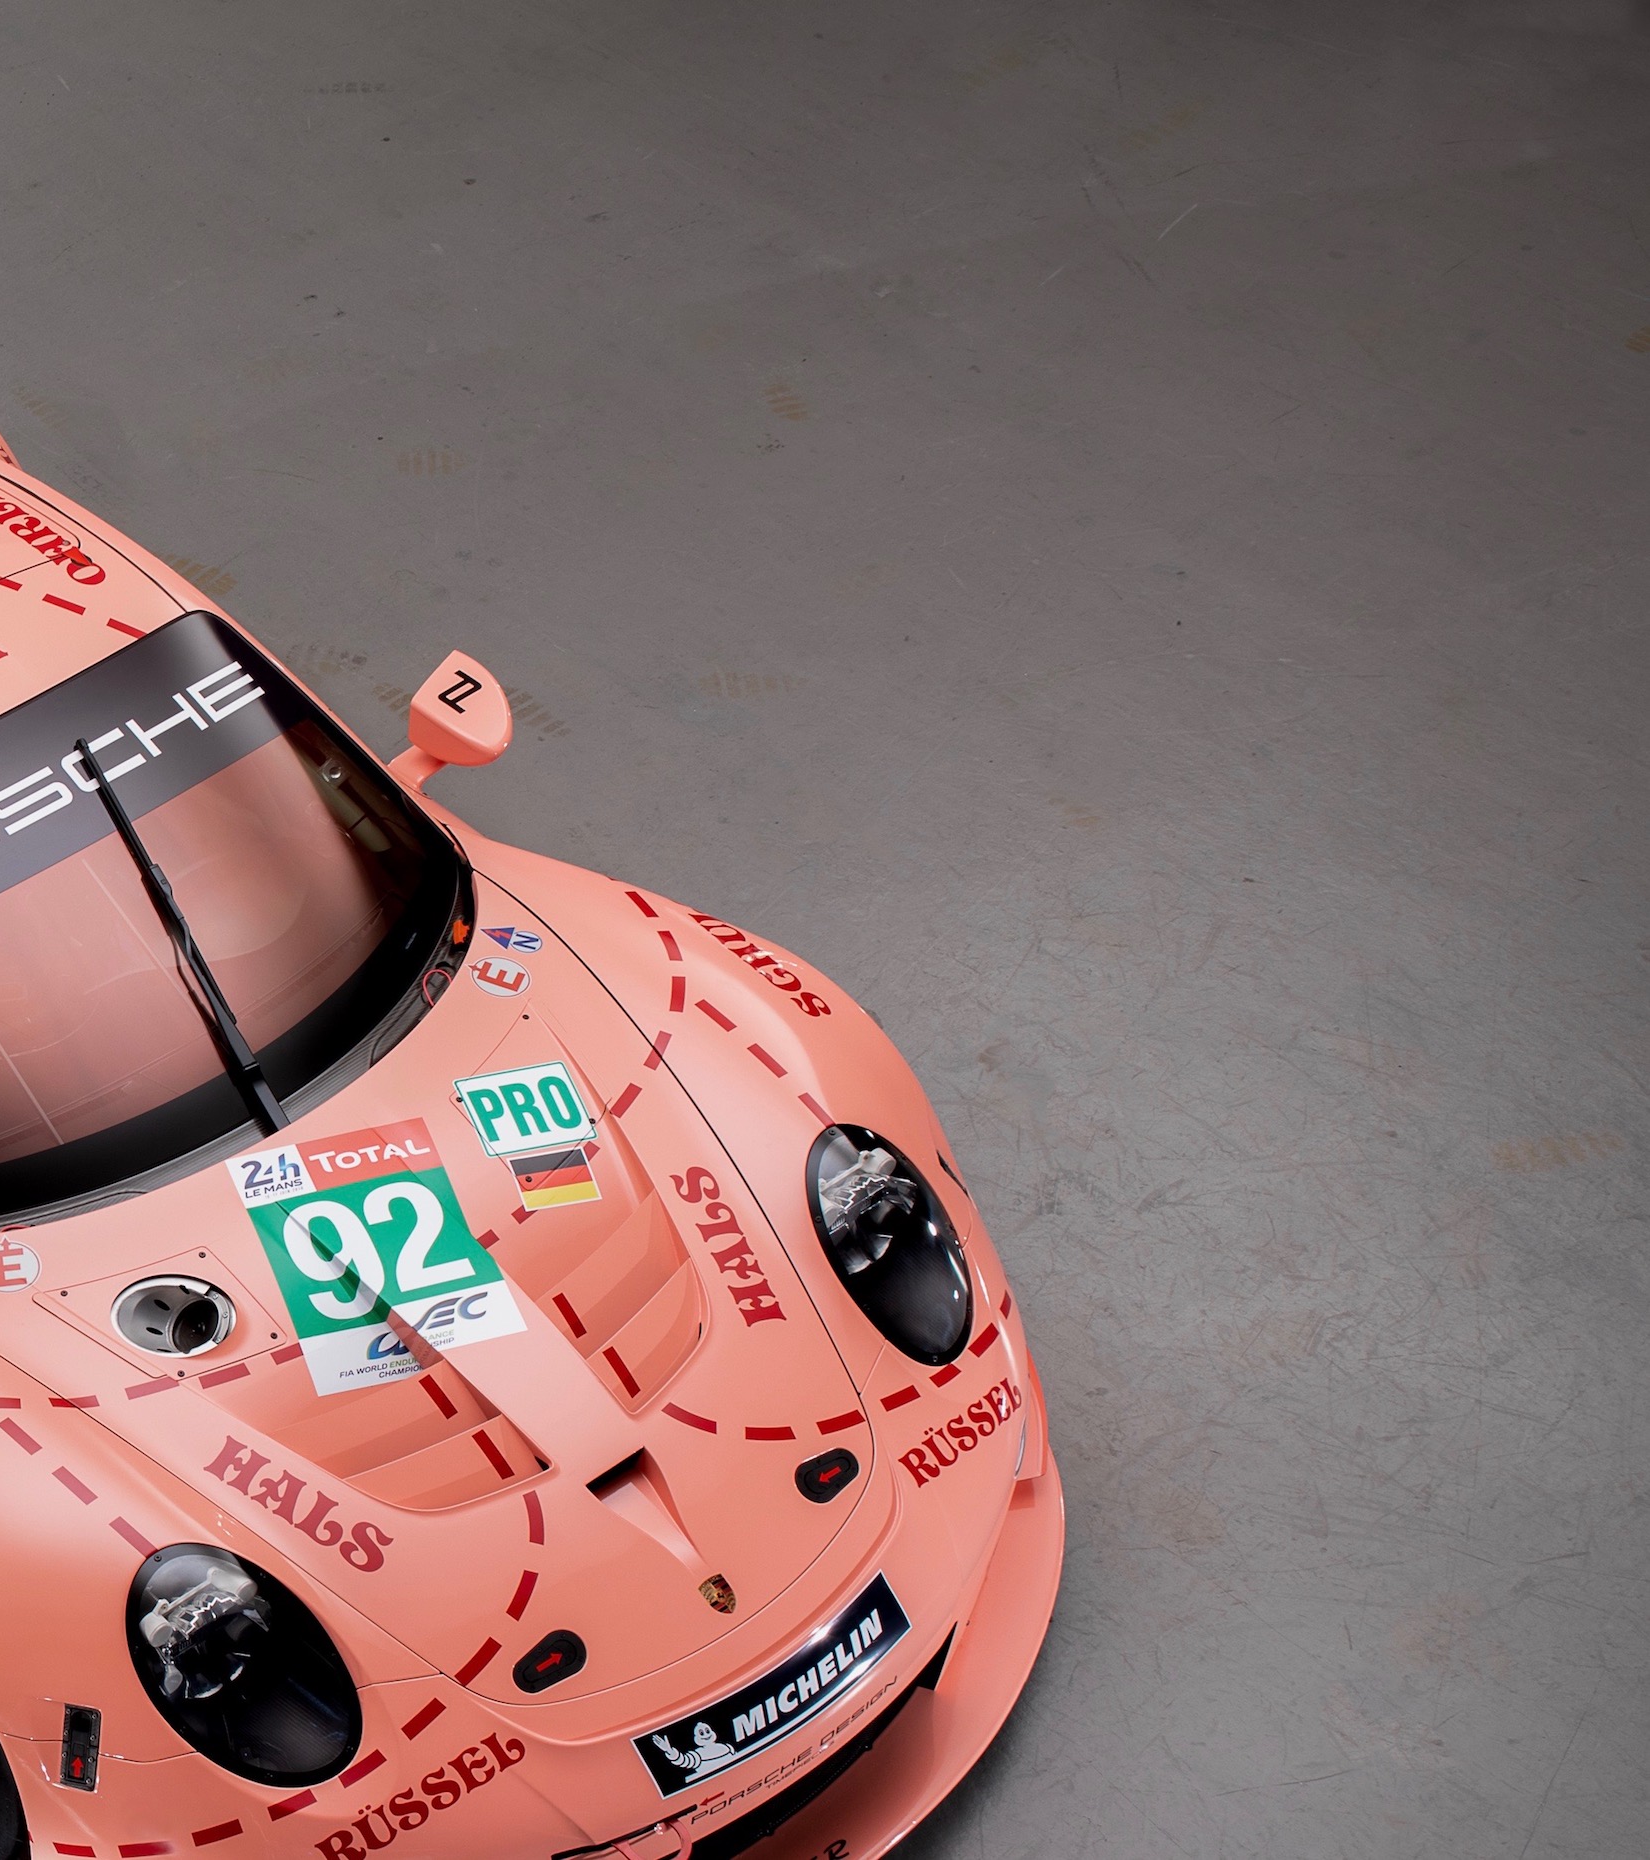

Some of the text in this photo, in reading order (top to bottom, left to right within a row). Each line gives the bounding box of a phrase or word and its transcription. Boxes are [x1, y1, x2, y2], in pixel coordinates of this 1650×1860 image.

[512, 933, 540, 950] N
[308, 1138, 432, 1173] TOTAL
[467, 1075, 582, 1142] PRO
[241, 1153, 301, 1190] 24h
[245, 1188, 262, 1199] LE
[264, 1178, 303, 1195] MANS
[282, 1181, 476, 1320] 92
[669, 1166, 787, 1327] HALS
[339, 1369, 355, 1379] FIA
[356, 1363, 388, 1376] WORLD
[898, 1377, 1023, 1488] RÜSSEL
[203, 1435, 394, 1573] HALS
[732, 1607, 885, 1743] MICHELIN
[314, 1732, 526, 1860] RÜSSEL
[690, 1675, 898, 1825] PORSCHE DESIGN
